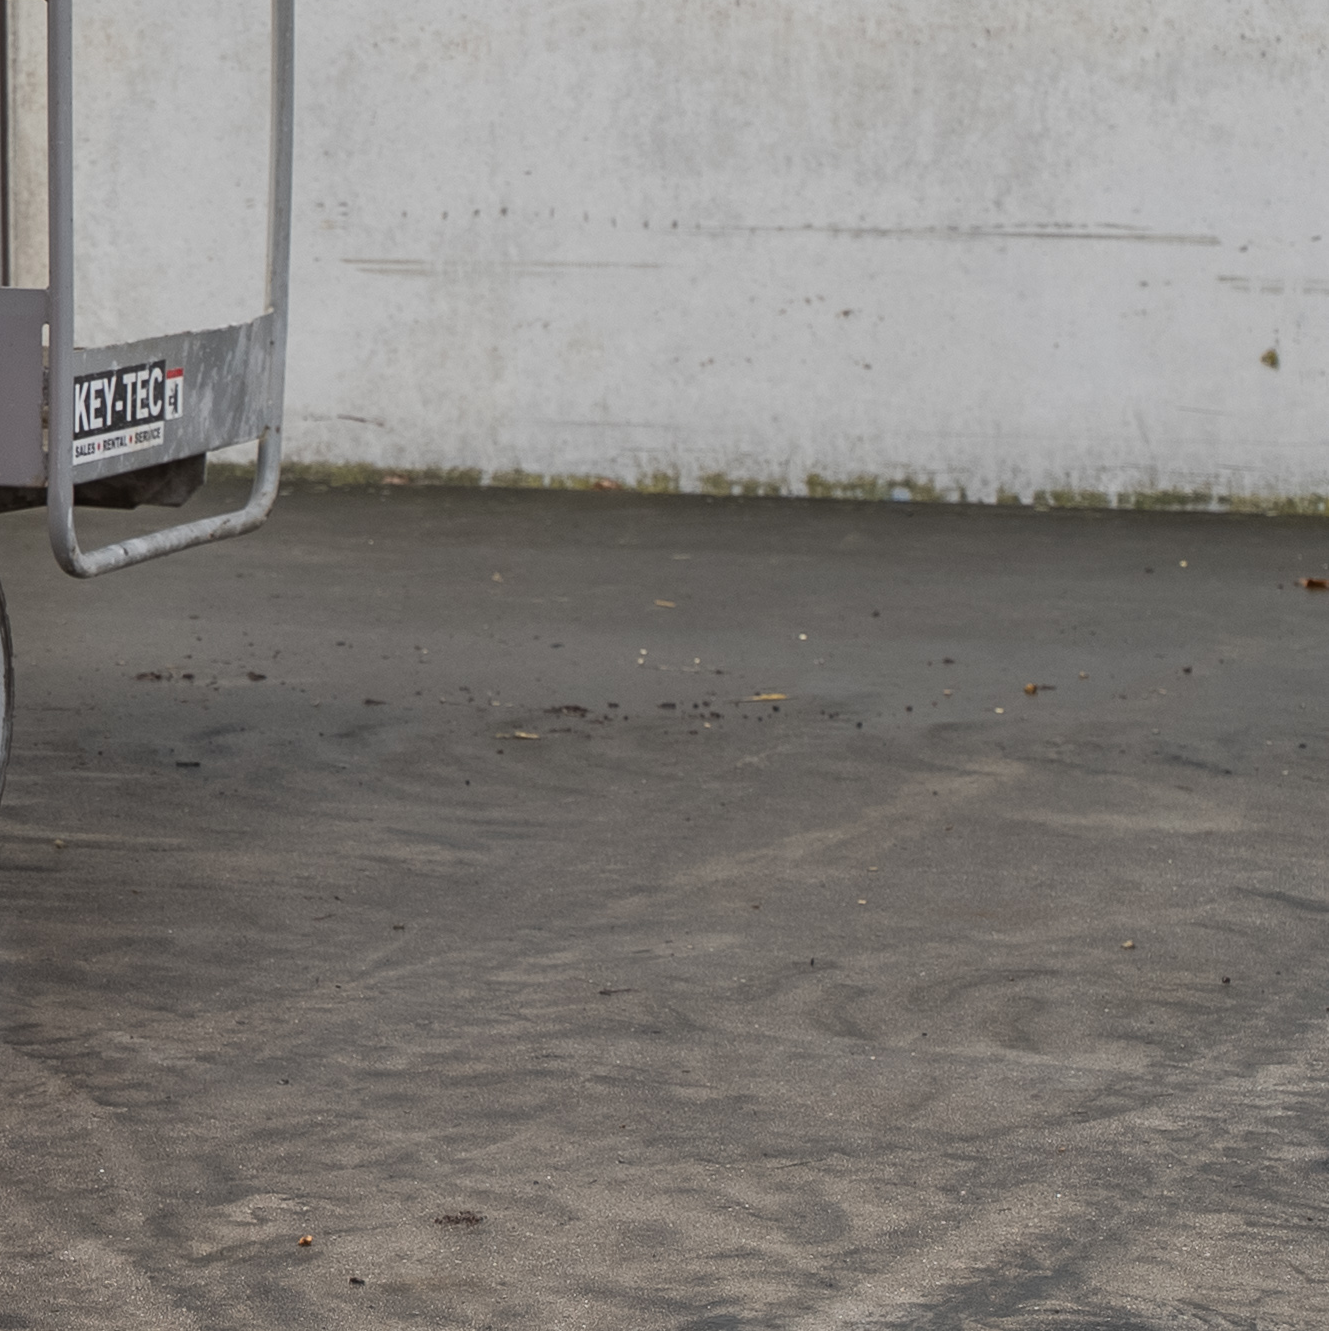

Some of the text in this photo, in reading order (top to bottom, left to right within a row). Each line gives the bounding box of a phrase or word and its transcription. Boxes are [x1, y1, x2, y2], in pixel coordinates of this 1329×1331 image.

[74, 367, 163, 434] KEY-TEC
[75, 427, 161, 458] SALES RENTAL SERVICE
